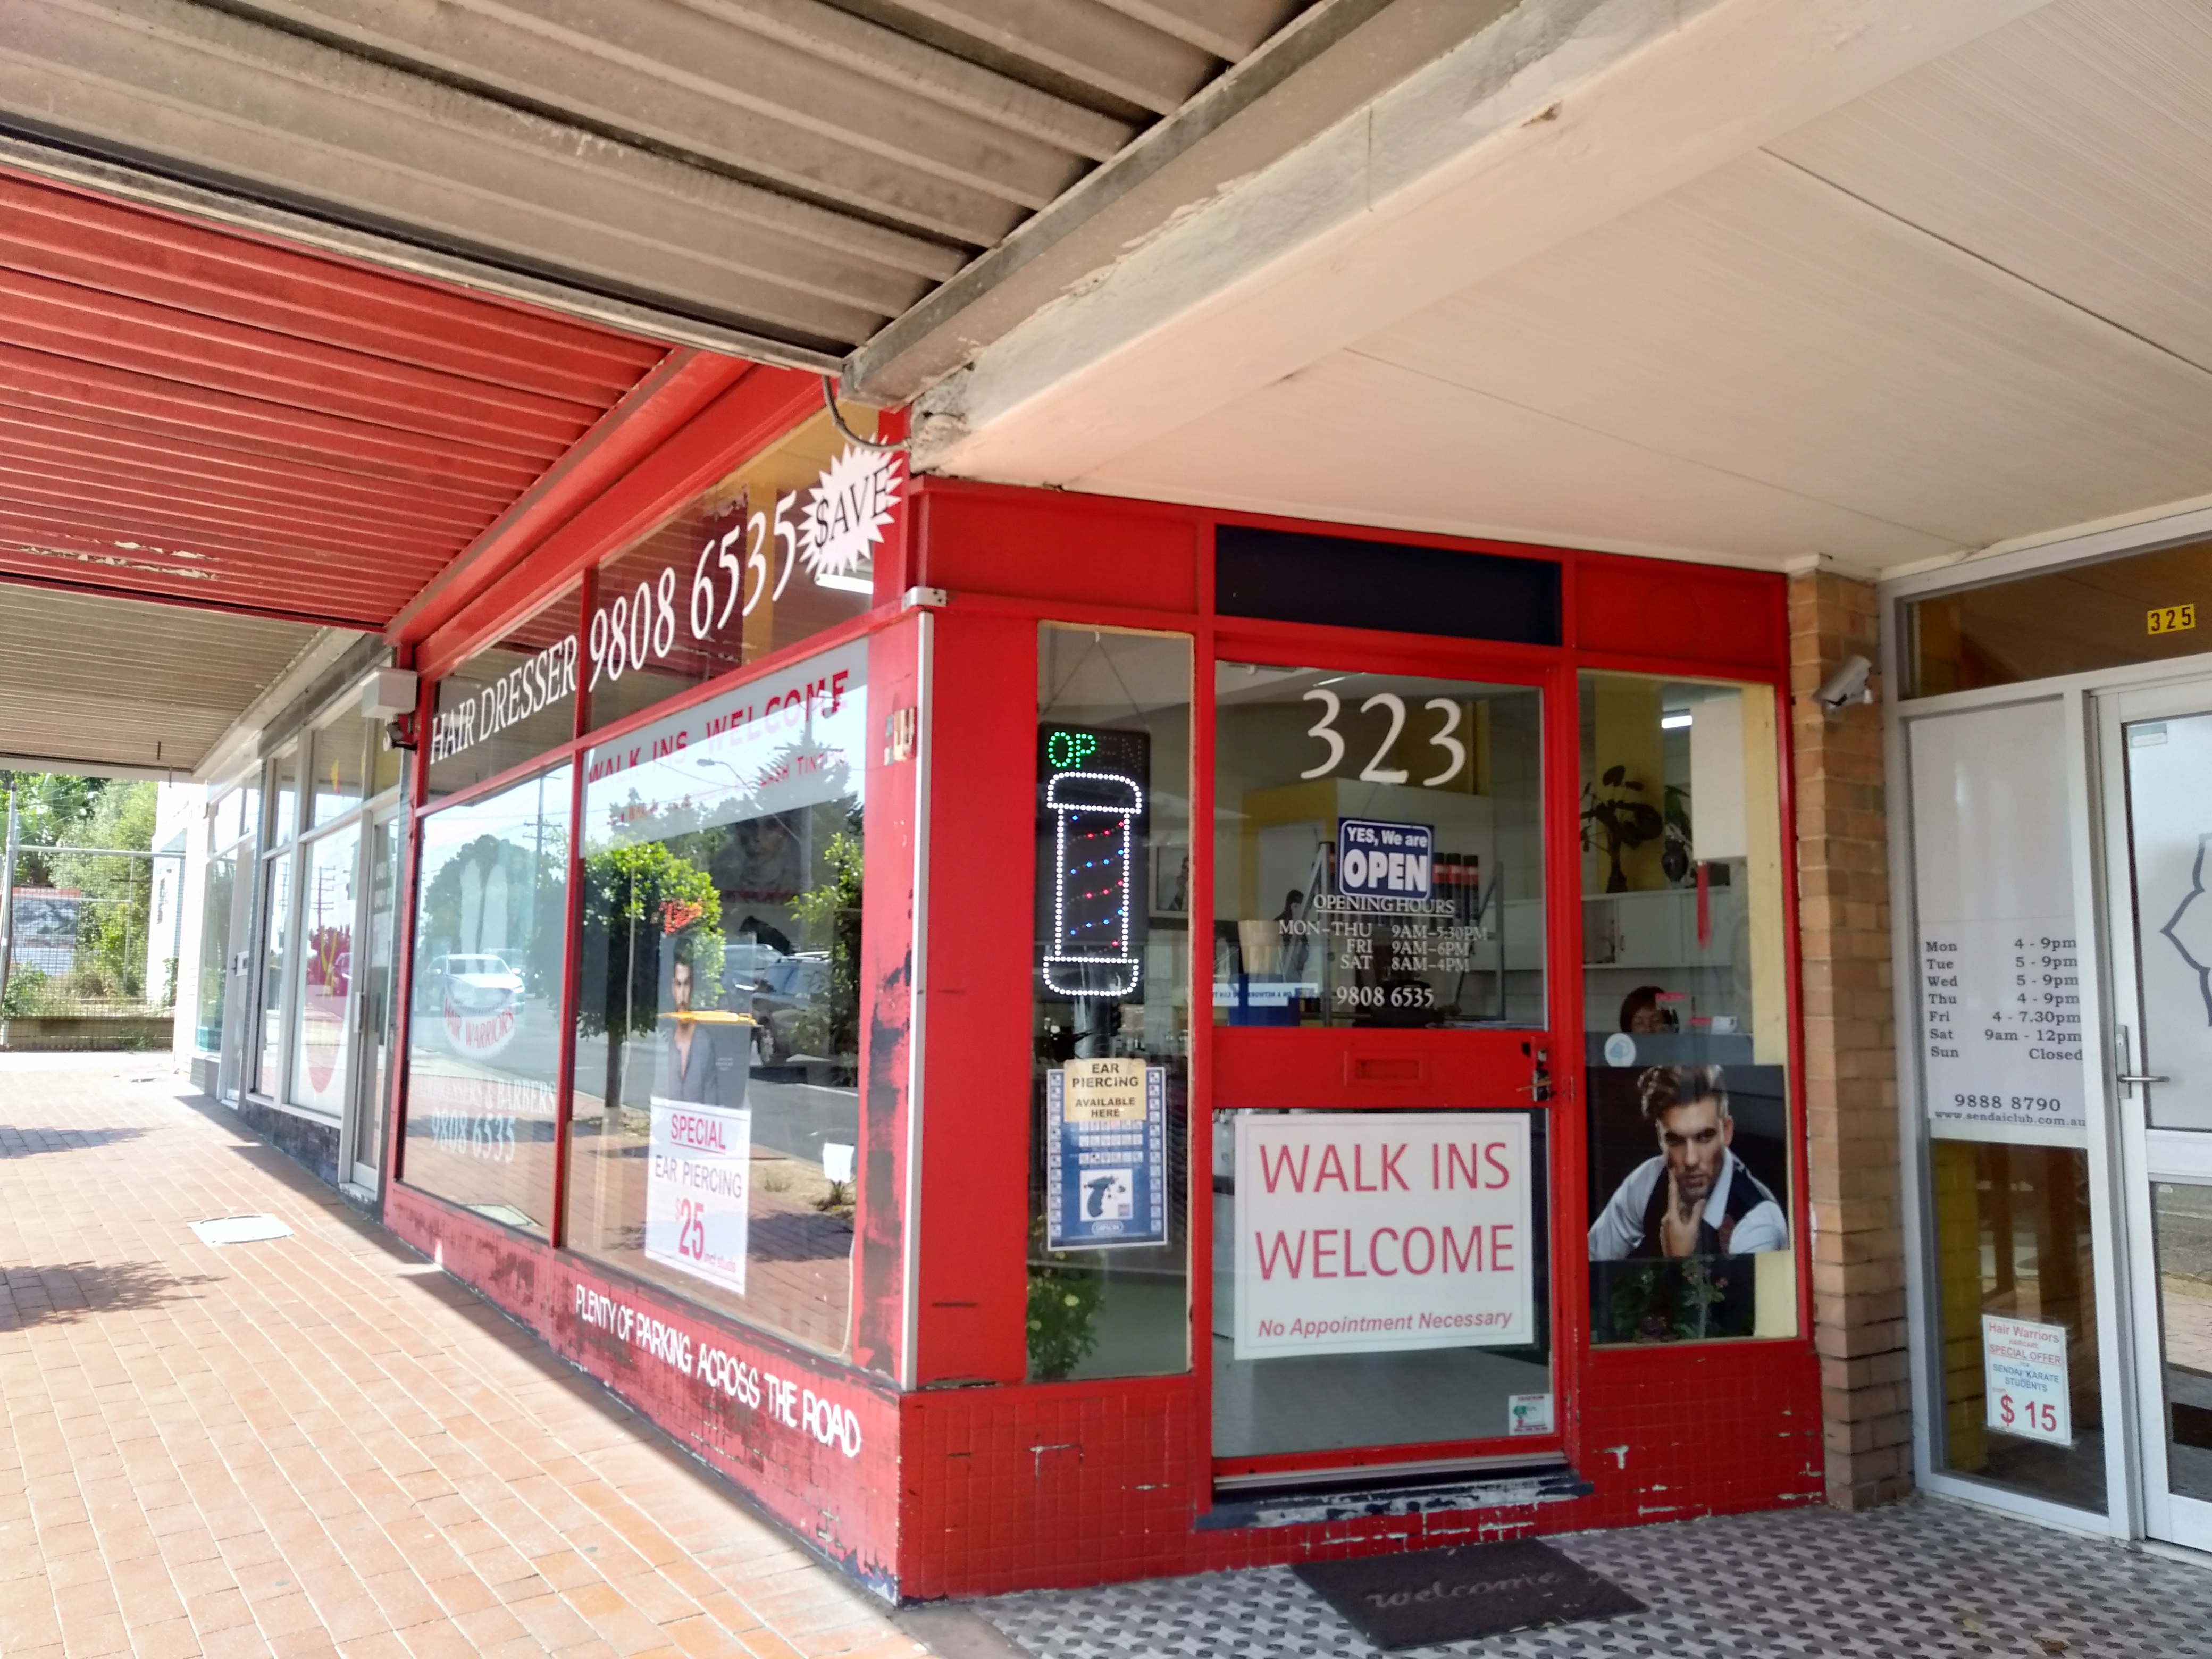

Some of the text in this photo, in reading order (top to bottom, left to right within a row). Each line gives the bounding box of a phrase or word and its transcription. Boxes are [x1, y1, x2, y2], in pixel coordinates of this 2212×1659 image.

[814, 465, 890, 553] $AVE
[430, 490, 797, 764] HAIR DRESSER 9808 6535
[2151, 607, 2191, 631] 325
[588, 669, 849, 790] WALK INS WELCOME
[1301, 689, 1466, 786] 323
[1347, 827, 1428, 848] YES, We are
[1344, 849, 1428, 892] OPEN
[1313, 894, 1455, 915] OPENING HOURS
[1279, 920, 1372, 937] MON-THU
[1346, 939, 1470, 956] FRI 9AM-6PM
[1926, 942, 1957, 952] Mon
[2014, 939, 2024, 949] 4
[2040, 937, 2077, 951] 9pm
[1340, 954, 1470, 973] SAT 8AM-4PM
[1927, 959, 1954, 969] Tue
[2015, 957, 2025, 967] 5
[2041, 956, 2078, 970] 9pm
[1928, 976, 1958, 987] Wed
[2016, 975, 2026, 986] 5
[2042, 974, 2079, 988] 9pm
[1336, 986, 1435, 1008] 9808 6535
[1928, 993, 1957, 1004] Thu
[2017, 993, 2027, 1003] 4
[2044, 993, 2080, 1007] 9pm
[1929, 1011, 1950, 1022] Fri
[1992, 1011, 2002, 1022] 4
[2019, 1011, 2081, 1026] 7.30pm
[1930, 1029, 1954, 1040] Sat
[1985, 1029, 2018, 1041] 9am
[2037, 1029, 2082, 1044] 12pm
[1931, 1046, 2083, 1061] Sun Closed
[1092, 1063, 1119, 1073] EAR
[1072, 1077, 1138, 1087] PIERCING
[497, 1077, 556, 1115] BARBERS
[1075, 1097, 1135, 1107] AVAILABLE
[1955, 1094, 2060, 1111] 9888 8790
[1091, 1109, 1120, 1117] HERE
[1935, 1111, 2086, 1127] www.sendaiclub.com.au
[472, 1112, 515, 1163] 6535
[671, 1114, 726, 1149] SPECIAL
[655, 1155, 742, 1199] EAR PIERCING
[1259, 1142, 1510, 1193] WALK INS
[1255, 1224, 1514, 1281] WELCOME
[1259, 1311, 1513, 1339] No Appointment Necessary
[1989, 1322, 2059, 1344] Hair Warriors
[1989, 1344, 2060, 1364] SPECIAL OFFER
[576, 1284, 862, 1458] PLENTY OF PARKING ACROSS THE ROAD
[2026, 1370, 2059, 1383] KARATE
[2005, 1377, 2048, 1392] STUDENTS
